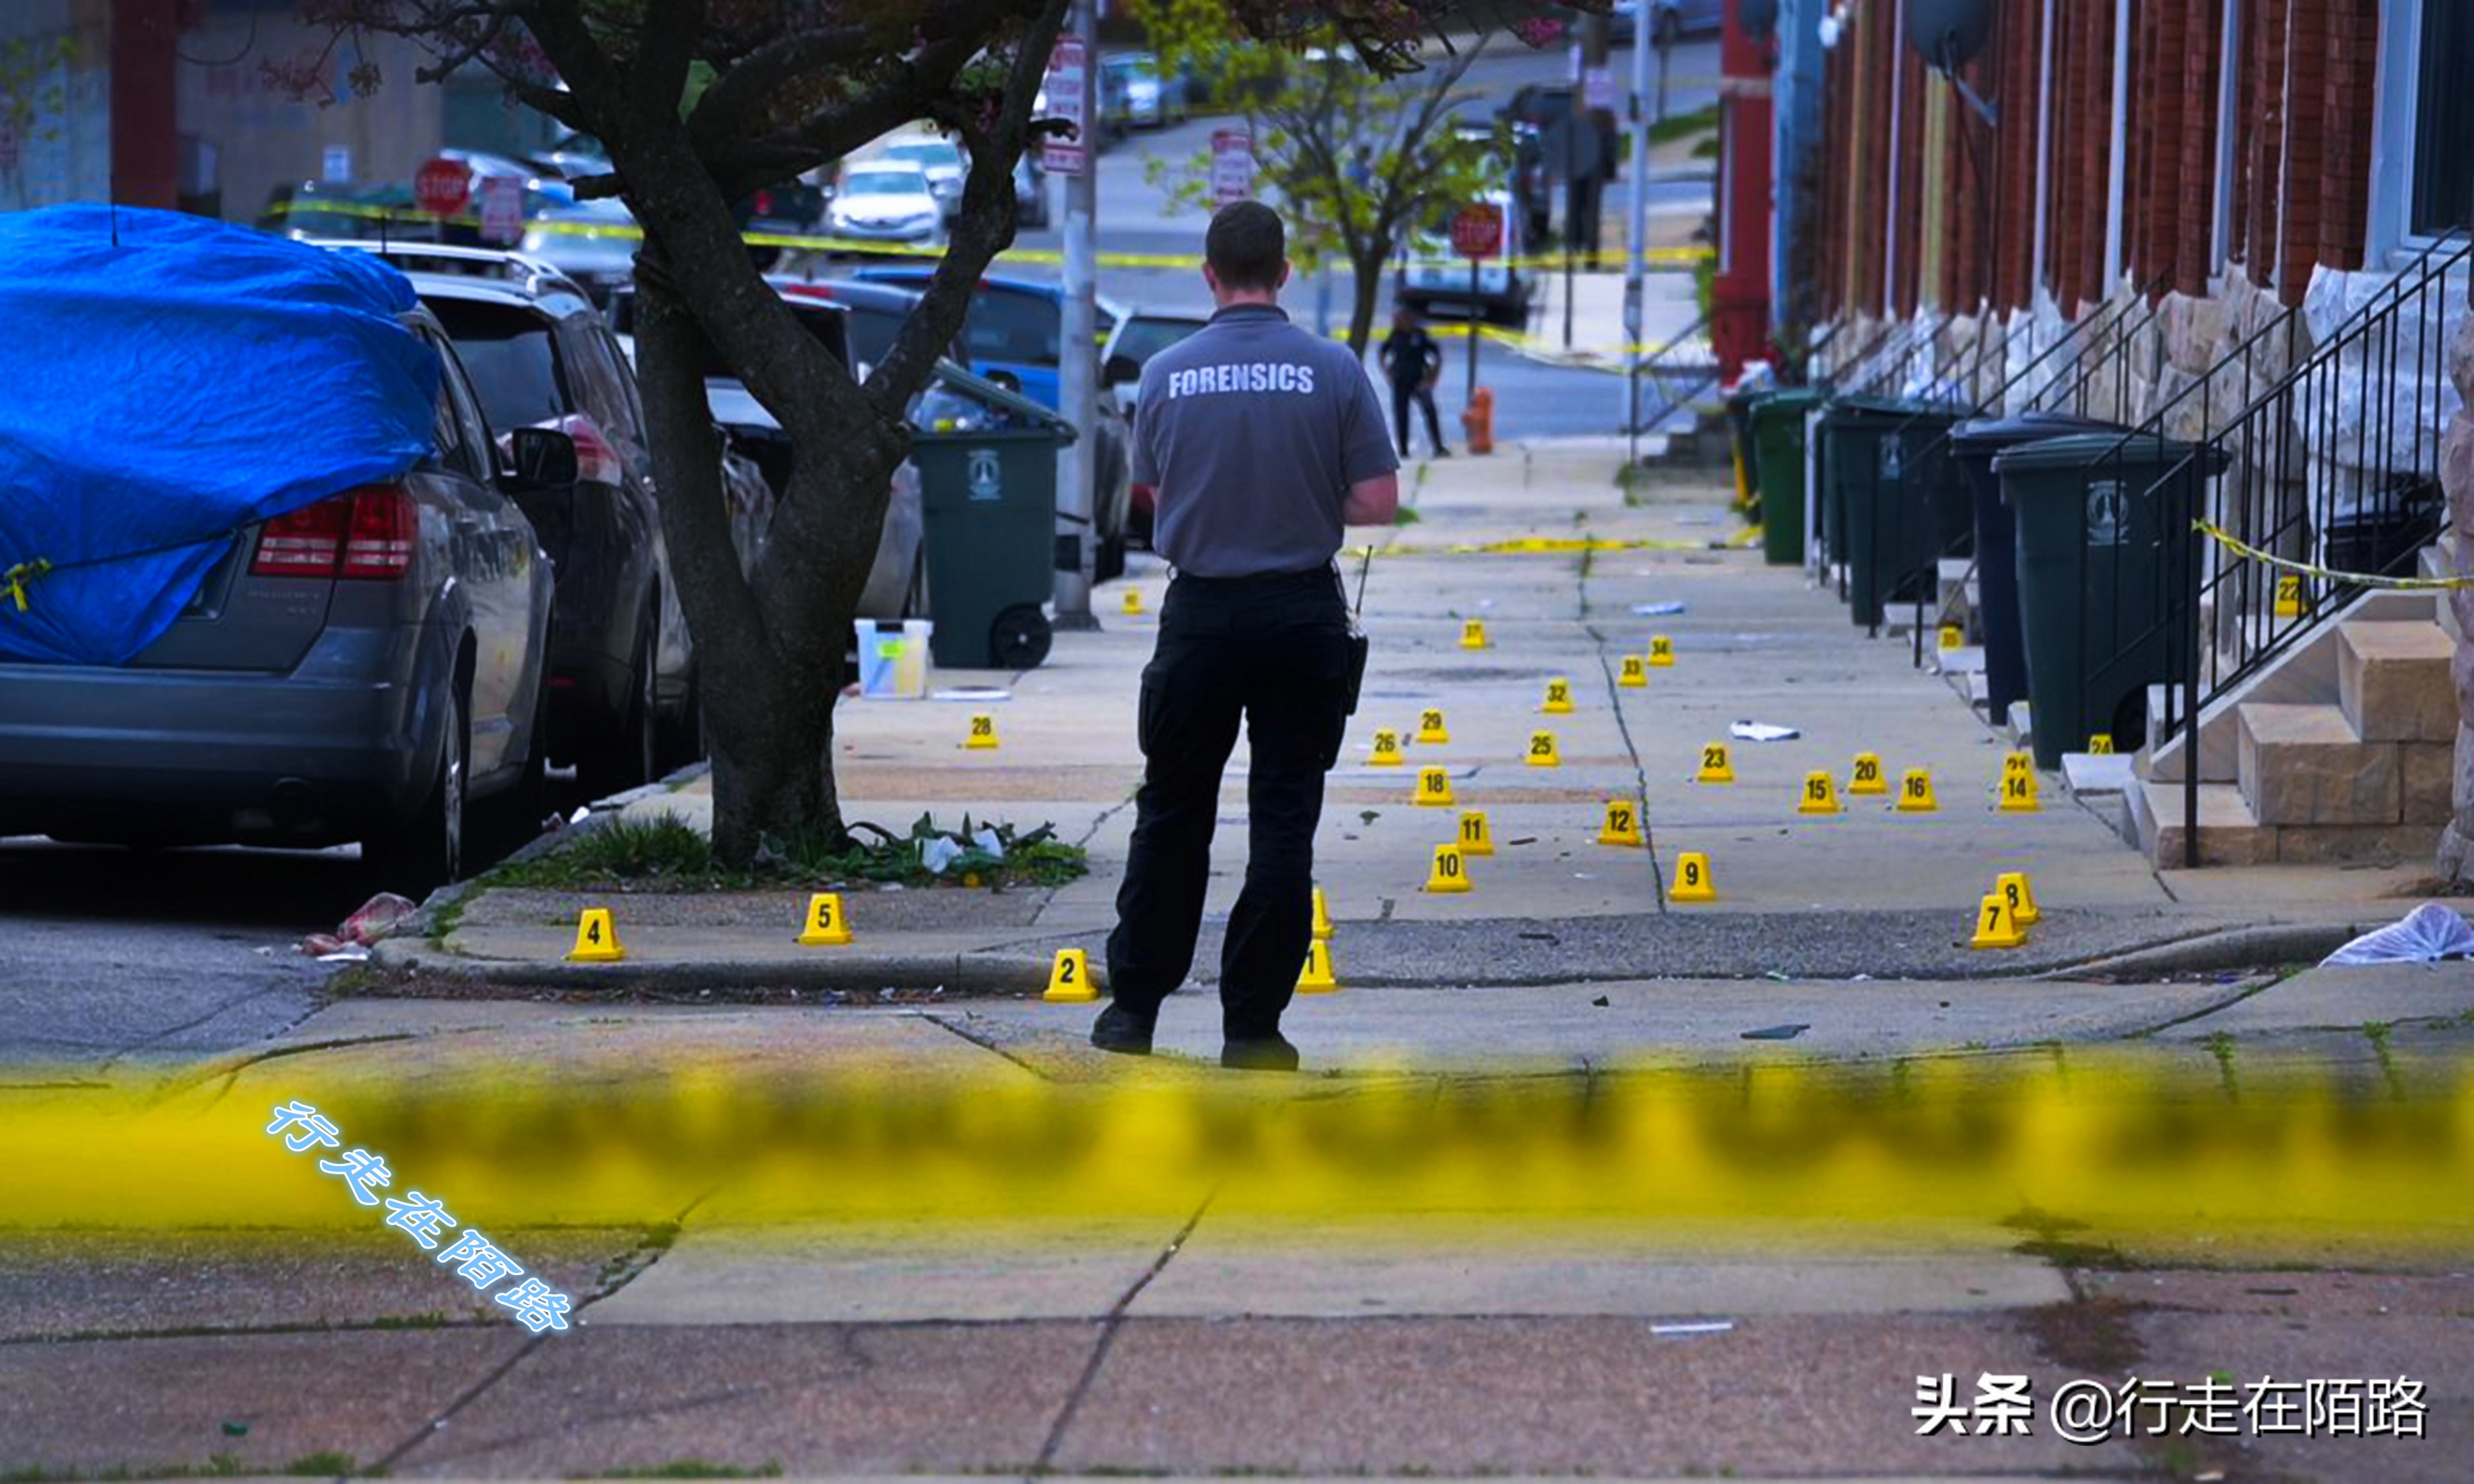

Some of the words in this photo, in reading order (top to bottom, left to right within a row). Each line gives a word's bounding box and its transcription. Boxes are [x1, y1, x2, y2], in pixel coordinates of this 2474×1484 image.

[1169, 363, 1314, 399] FORENSICS
[2279, 582, 2299, 602] 22
[1547, 684, 1566, 702] 32
[972, 717, 991, 736] 28
[1423, 712, 1442, 731] 29
[1375, 734, 1395, 752] 26
[1531, 736, 1551, 755] 25
[1705, 748, 1725, 768] 23
[1856, 761, 1876, 780] 20
[1427, 773, 1444, 792] 18
[1807, 780, 1826, 800] 15
[1906, 778, 1925, 797] 16
[2009, 778, 2026, 797] 14
[1463, 819, 1480, 840] 11
[1609, 810, 1629, 832] 12
[1437, 854, 1458, 877] 10
[1686, 862, 1699, 885] 9
[2006, 883, 2018, 908] 8
[818, 904, 830, 928] 5
[1988, 906, 2000, 931] 7
[587, 920, 600, 944] 4
[1060, 958, 1074, 983] 2
[1307, 950, 1314, 974] 1
